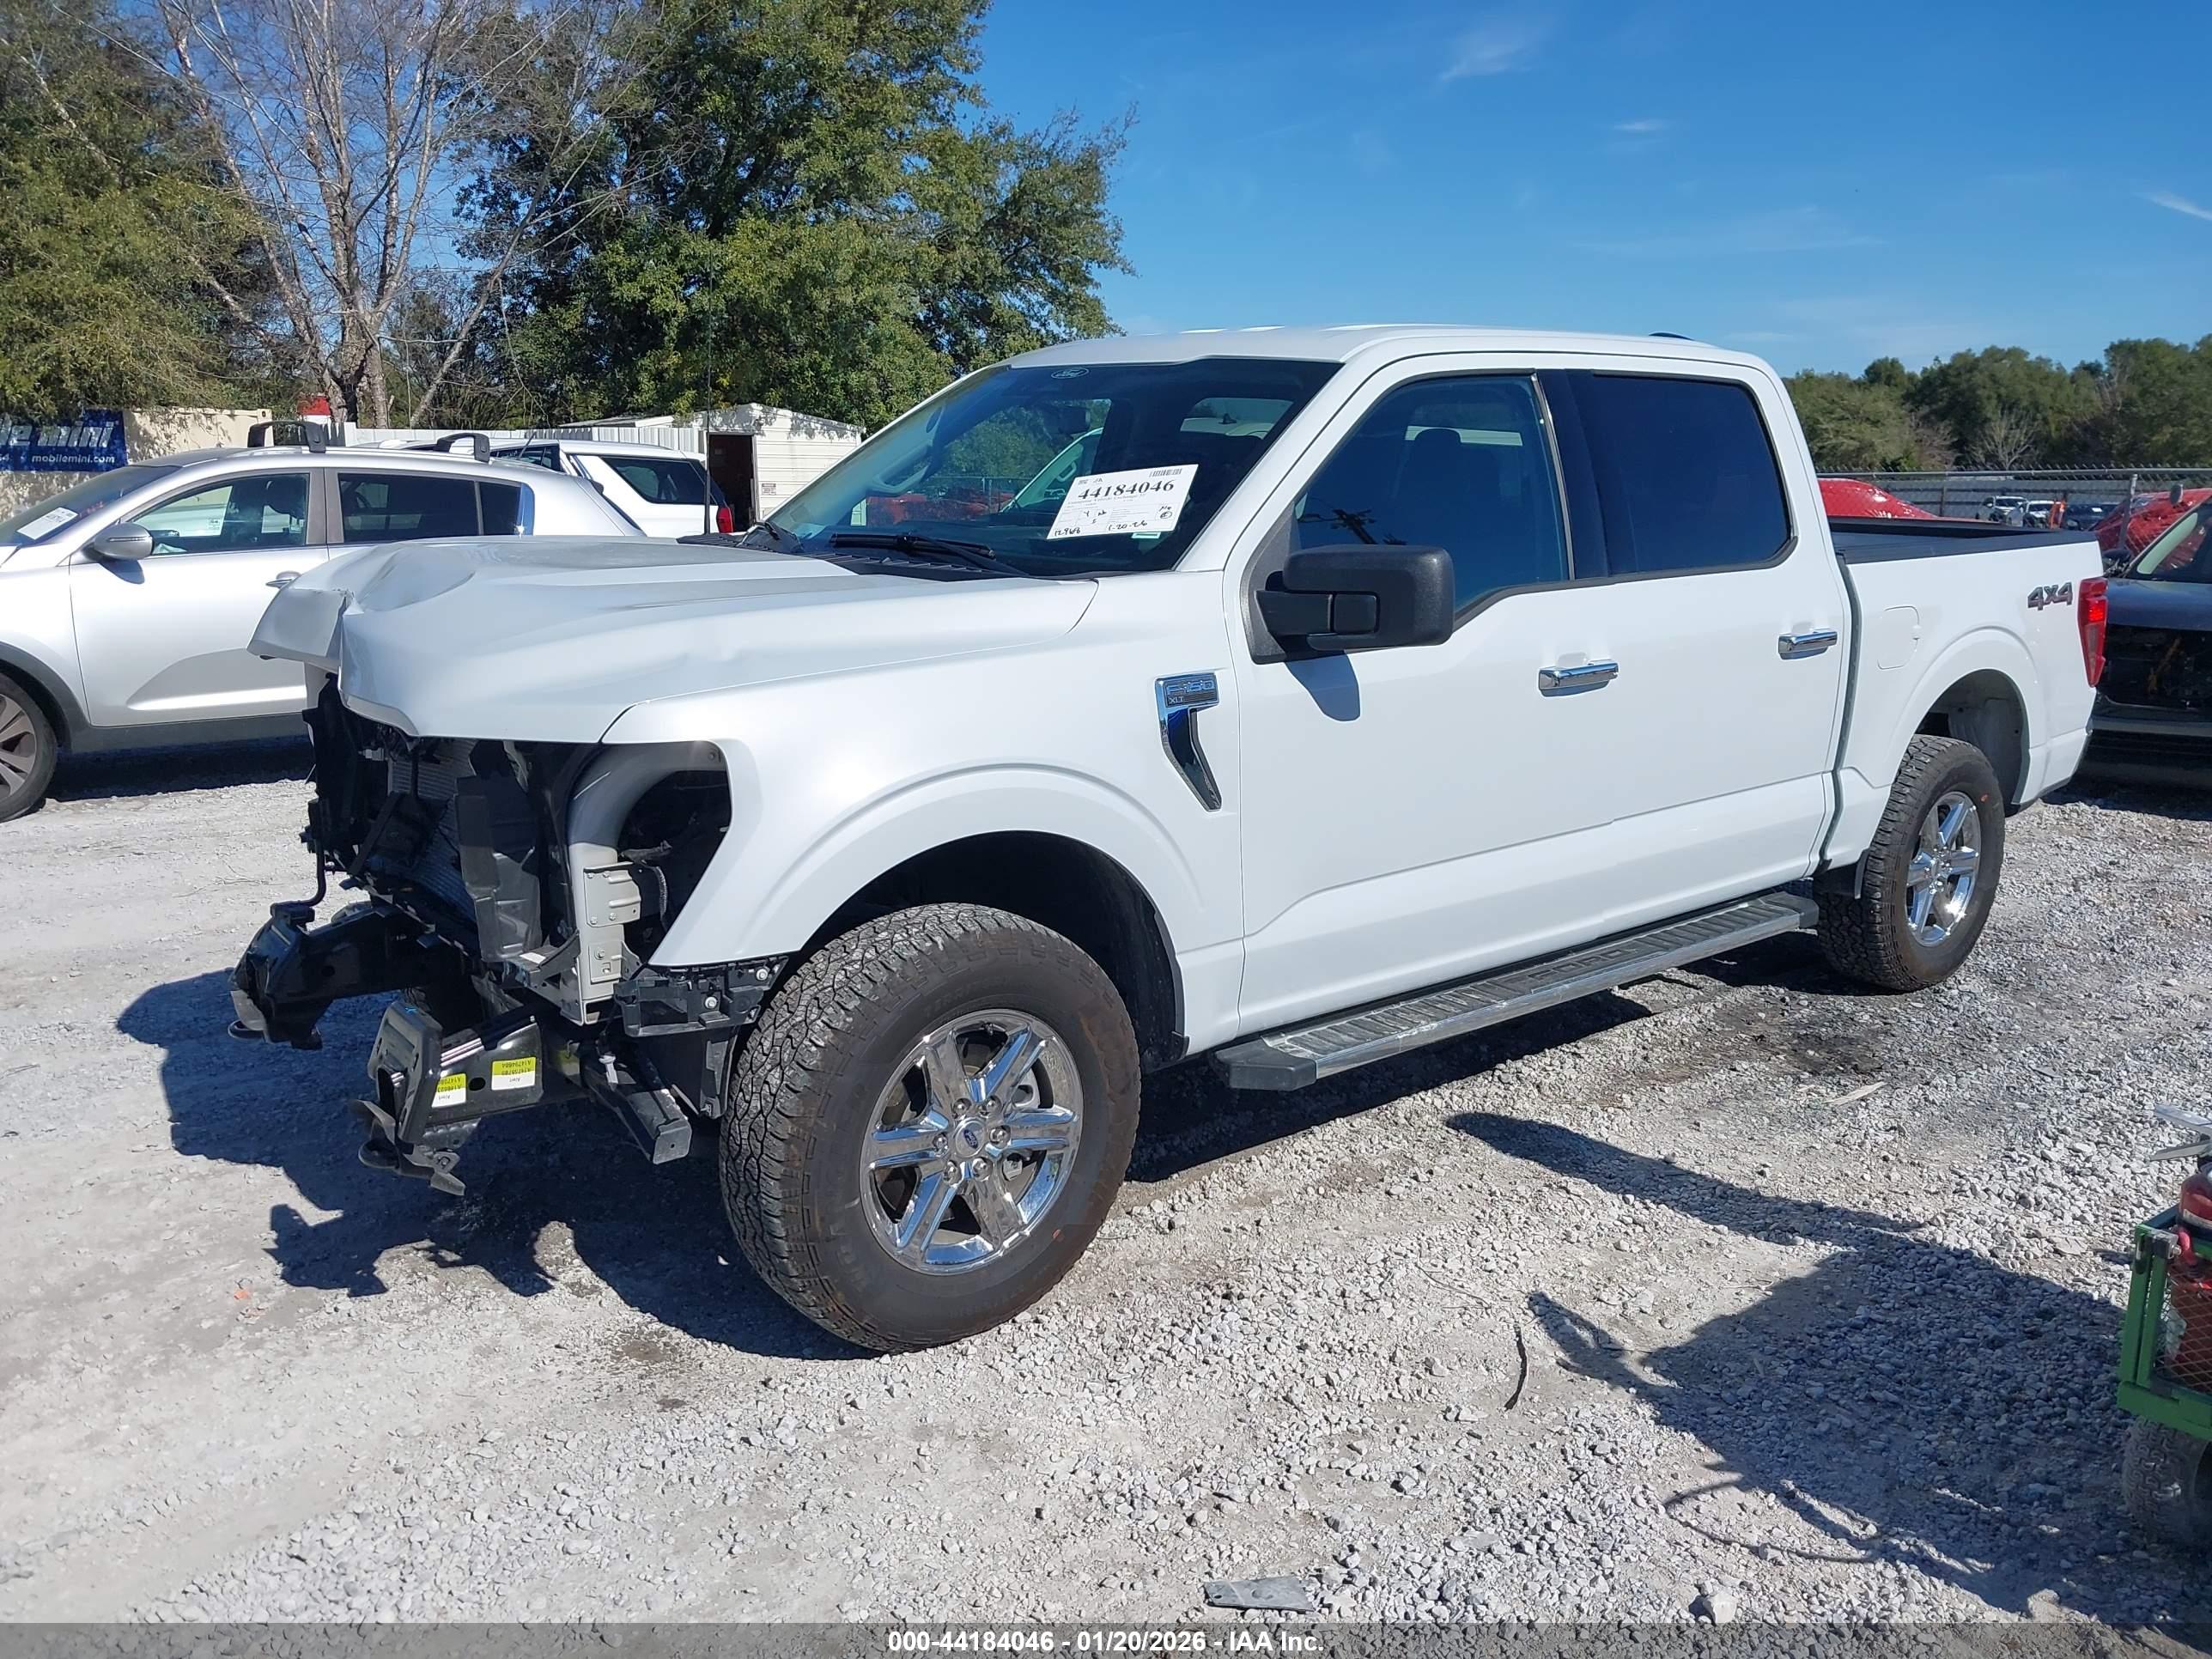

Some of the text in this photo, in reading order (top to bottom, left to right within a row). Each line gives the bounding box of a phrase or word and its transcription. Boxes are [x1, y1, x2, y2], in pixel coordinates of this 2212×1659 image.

[38, 421, 114, 447] mini
[32, 454, 115, 464] mobilemini.com
[1078, 479, 1176, 500] 44184046
[1167, 680, 1215, 695] F-150
